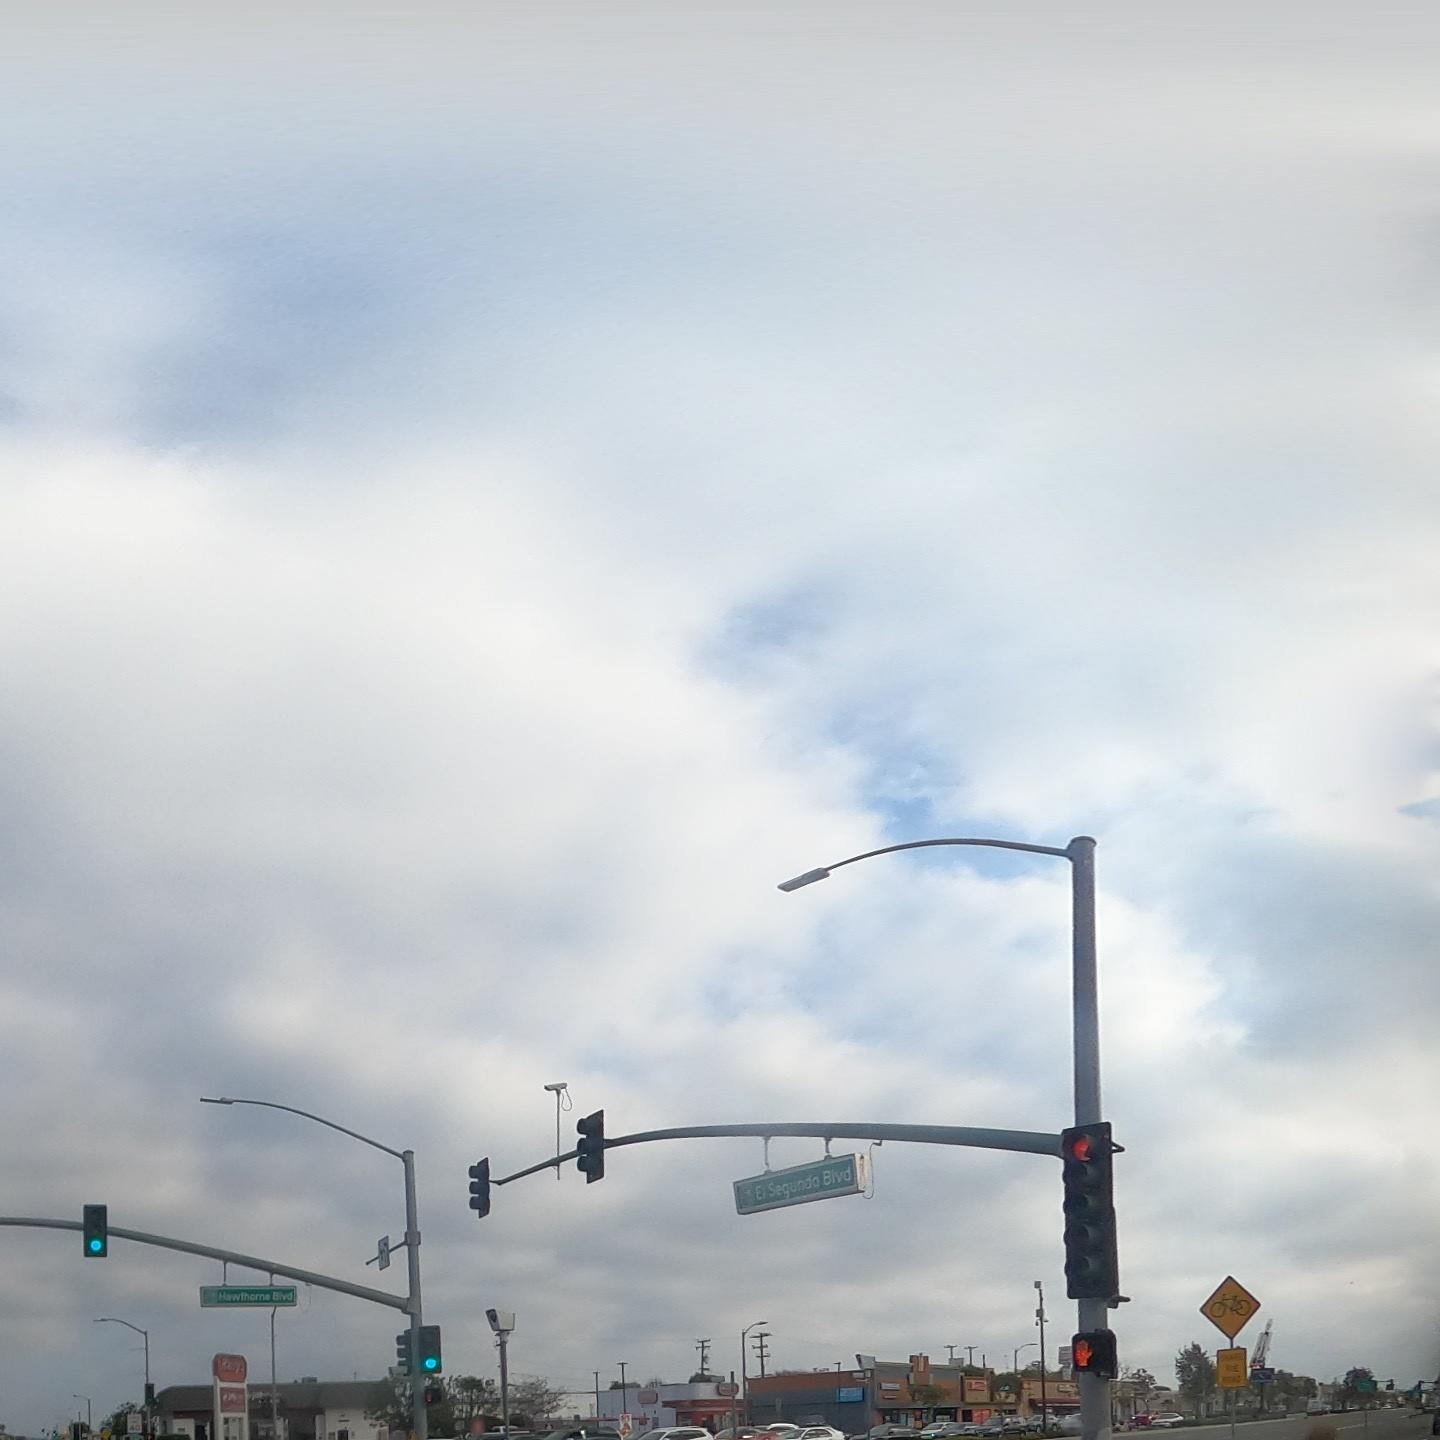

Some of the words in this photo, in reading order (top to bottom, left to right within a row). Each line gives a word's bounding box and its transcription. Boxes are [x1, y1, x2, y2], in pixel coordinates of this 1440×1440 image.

[755, 1185, 766, 1200] El
[769, 1175, 820, 1199] Segundo
[822, 1166, 852, 1186] Blvd
[218, 1290, 271, 1302] Hawthorne
[272, 1290, 294, 1301] Blvd
